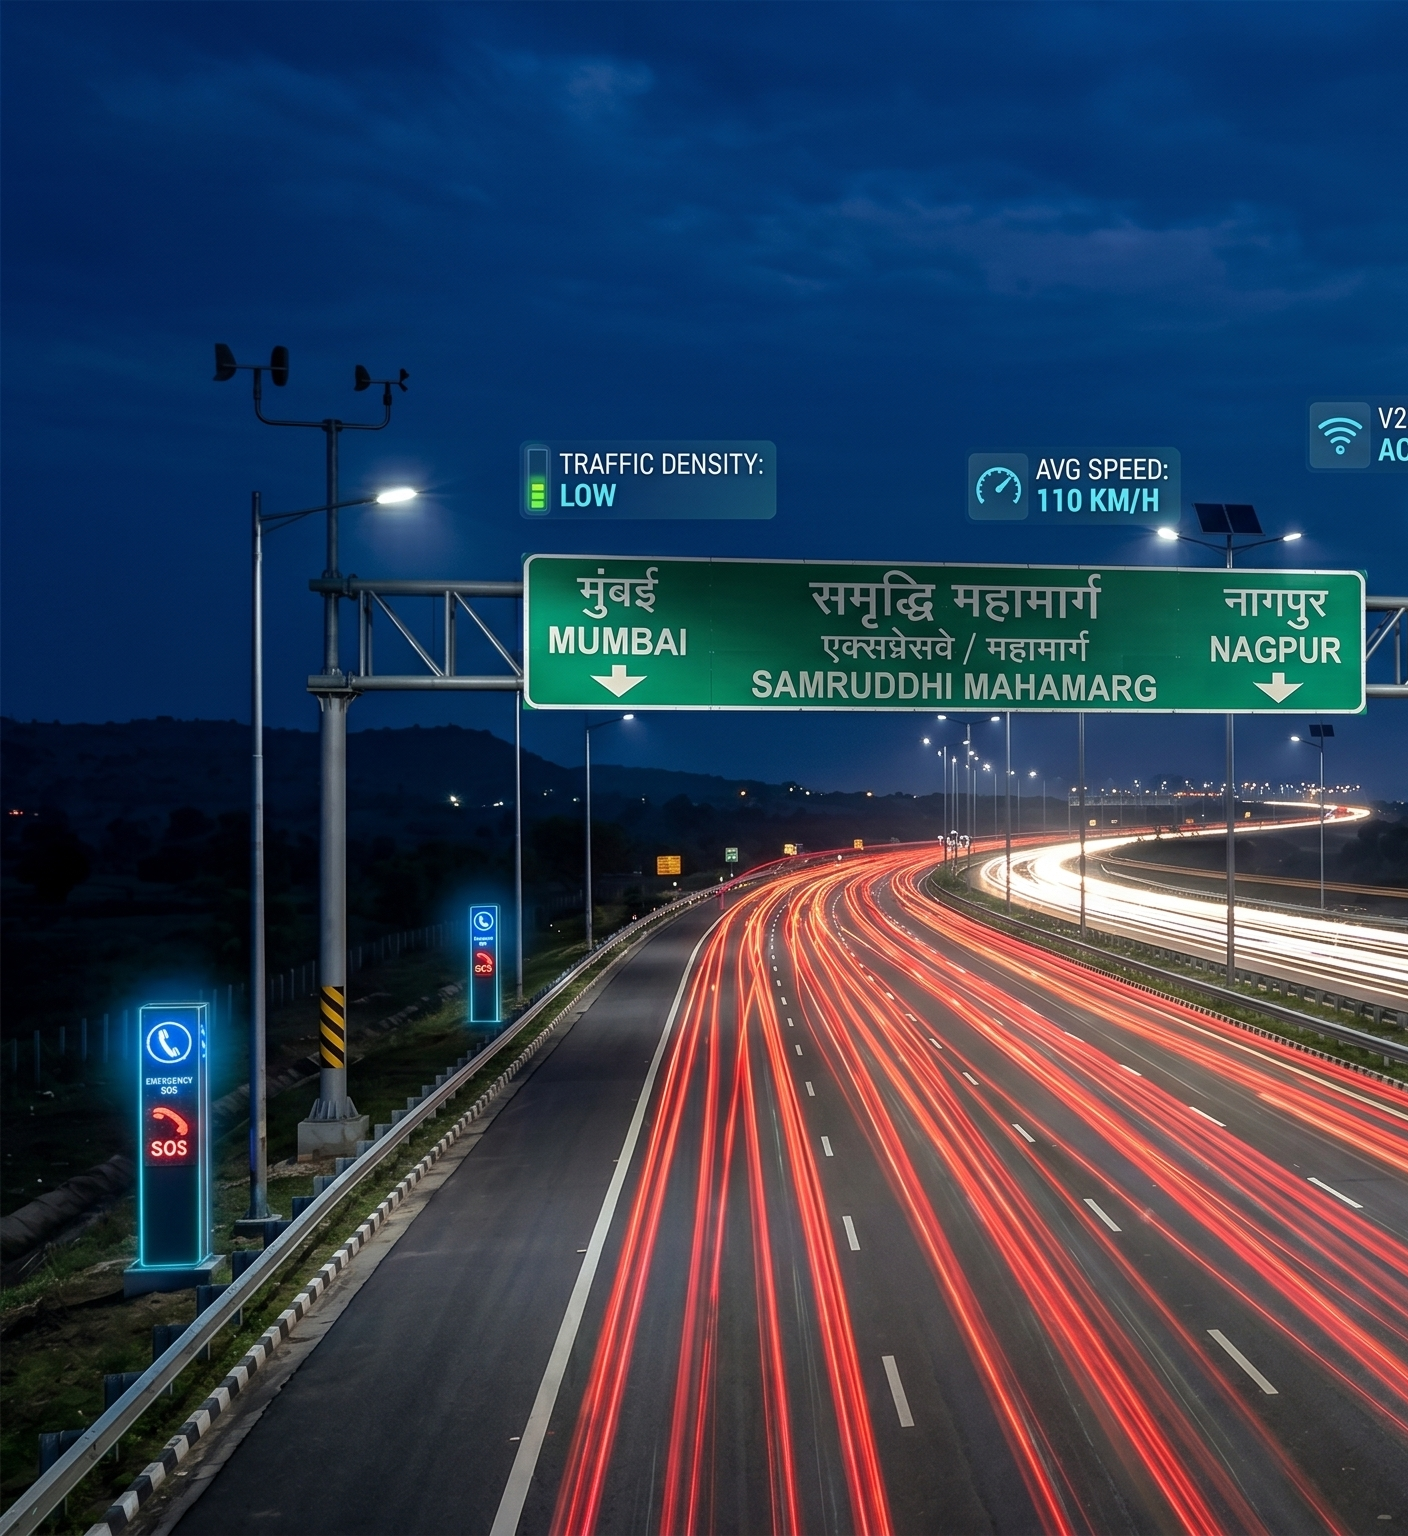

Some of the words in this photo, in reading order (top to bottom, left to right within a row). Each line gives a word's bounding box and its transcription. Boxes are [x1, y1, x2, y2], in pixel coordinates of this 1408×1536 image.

[576, 566, 659, 619] मुंबई
[808, 569, 936, 629] समृद्धि
[951, 573, 1102, 622] महामार्ग
[1223, 588, 1329, 631] नागपुर
[548, 625, 688, 656] MUMBAI
[985, 630, 1090, 663] महामार्ग
[1210, 635, 1342, 664] NAGPUR
[751, 669, 952, 702] SAMRUDDHI
[964, 672, 1157, 703] MAHAMARG
[145, 1076, 193, 1086] EMERGENCY
[160, 1086, 178, 1095] SOS
[151, 1139, 188, 1157] SOS
